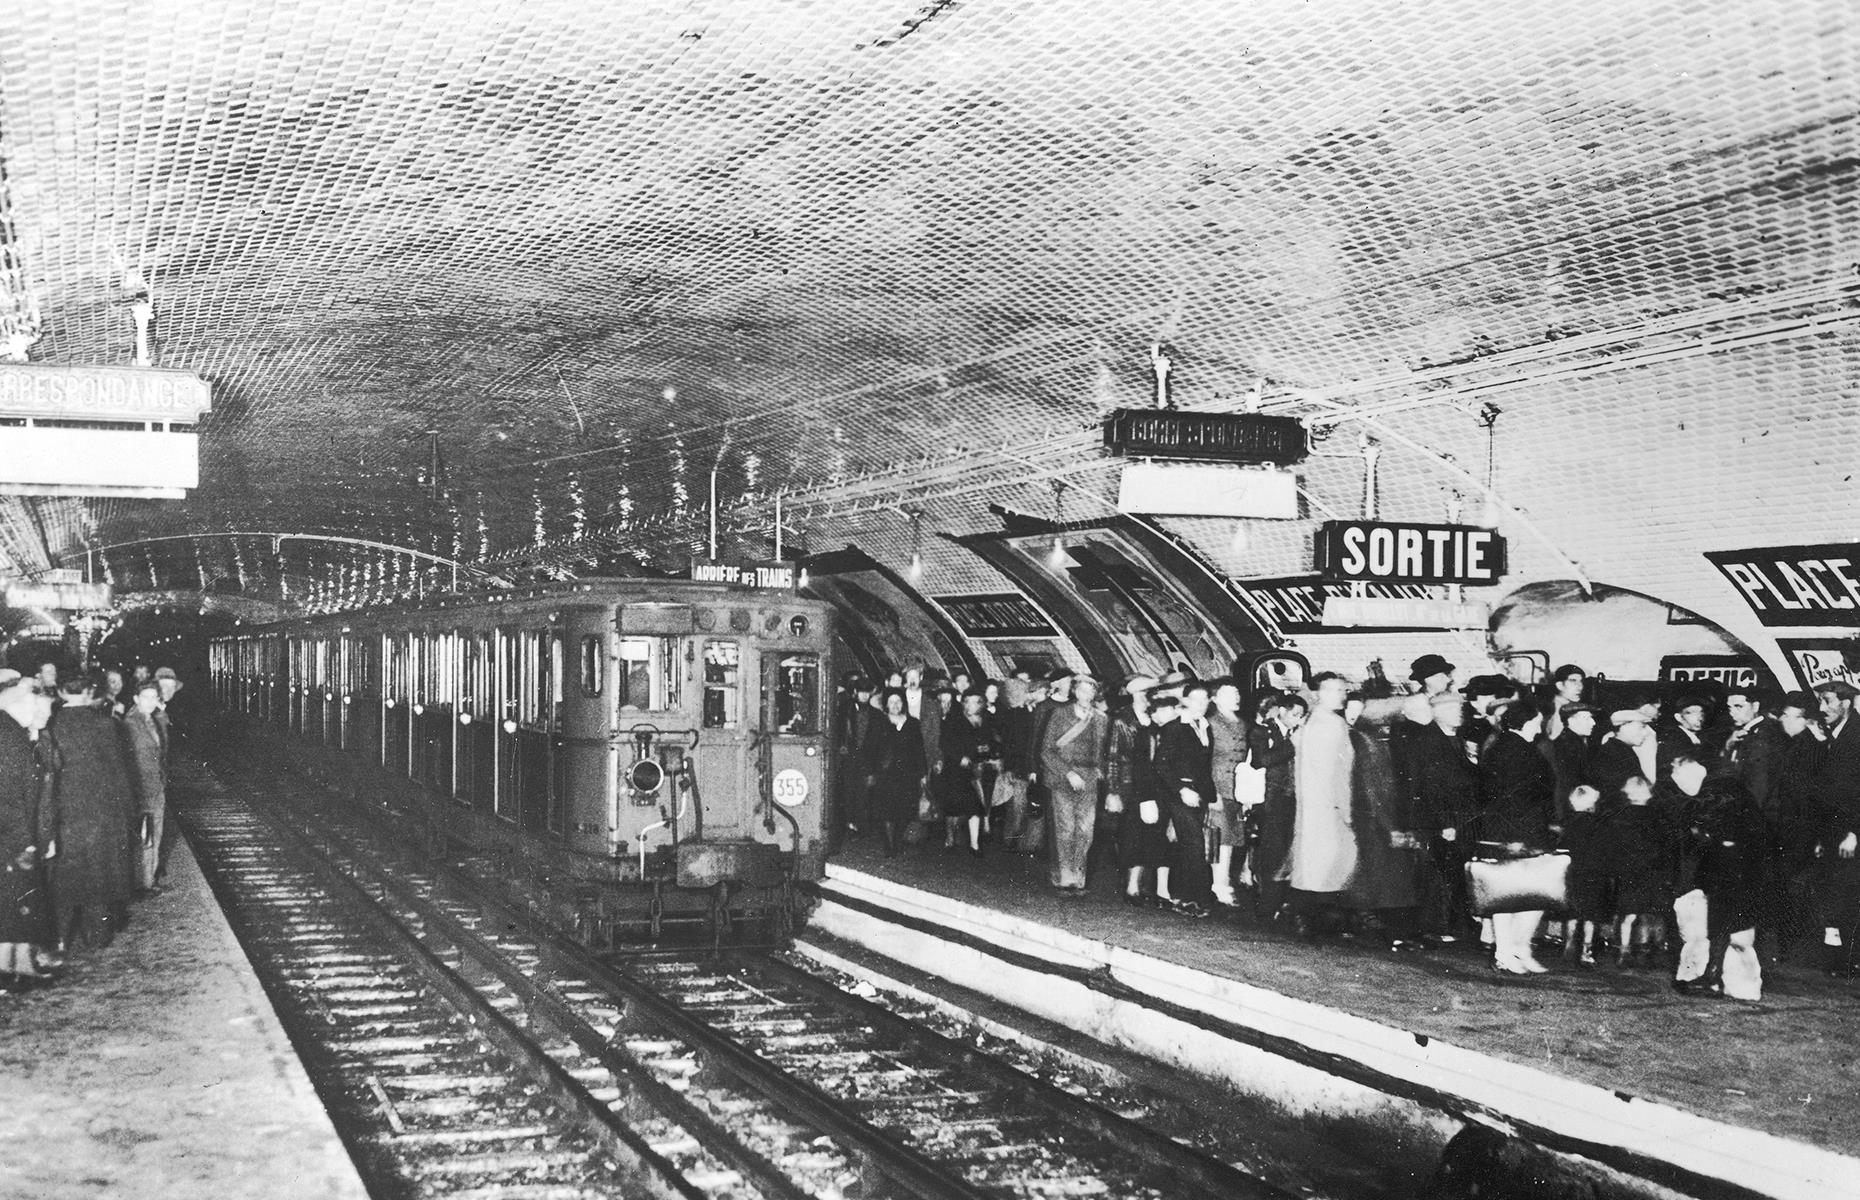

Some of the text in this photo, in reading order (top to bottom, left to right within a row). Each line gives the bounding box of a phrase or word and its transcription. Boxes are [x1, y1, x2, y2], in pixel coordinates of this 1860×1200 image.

[0, 373, 187, 407] RRESPONDANCE
[1342, 526, 1492, 579] SORTIE
[756, 567, 793, 589] TRAINS
[777, 778, 804, 797] 355
